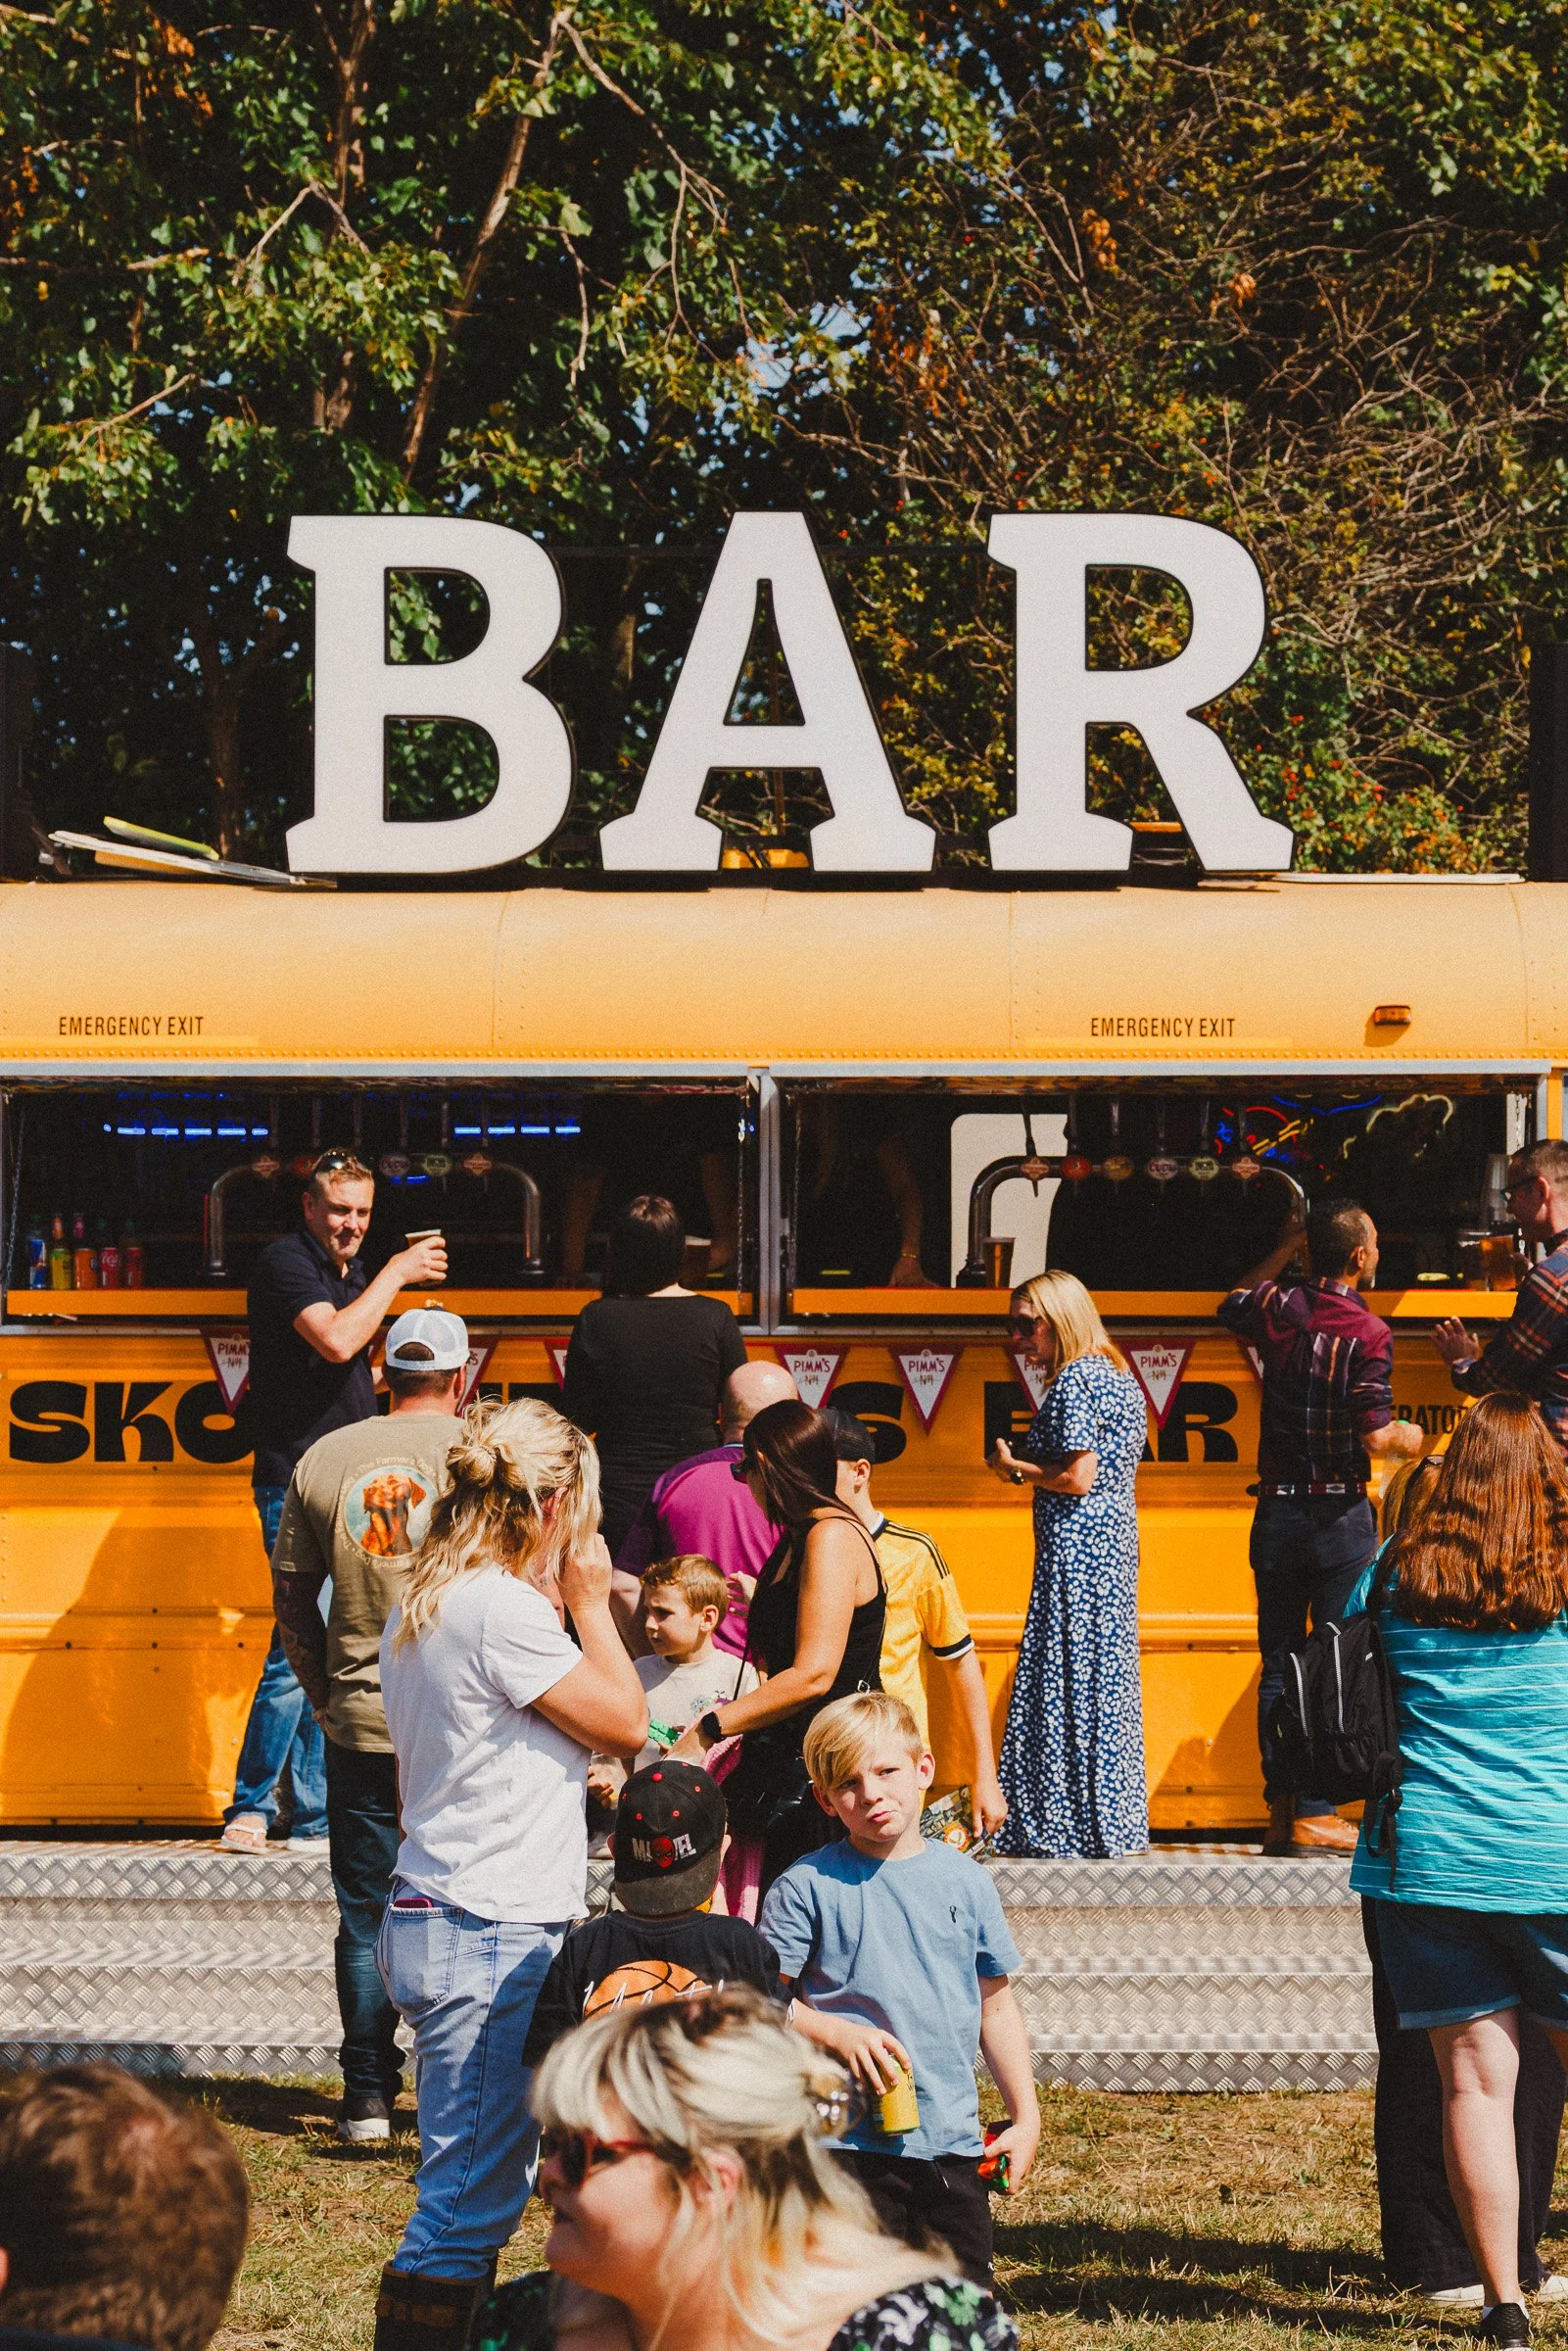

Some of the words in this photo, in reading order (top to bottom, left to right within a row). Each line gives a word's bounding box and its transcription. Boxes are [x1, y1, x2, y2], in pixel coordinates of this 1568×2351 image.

[286, 512, 1294, 872] BAR
[59, 1017, 162, 1035] EMERGENCY
[167, 1017, 204, 1035] EXIT
[1091, 1018, 1193, 1037] EMERGENCY
[1200, 1018, 1235, 1037] EXIT
[217, 1340, 250, 1356] PIMM'
[794, 1358, 831, 1373] PIMM'S
[909, 1358, 945, 1373] PIMM'S
[1140, 1352, 1177, 1368] PIMM'S
